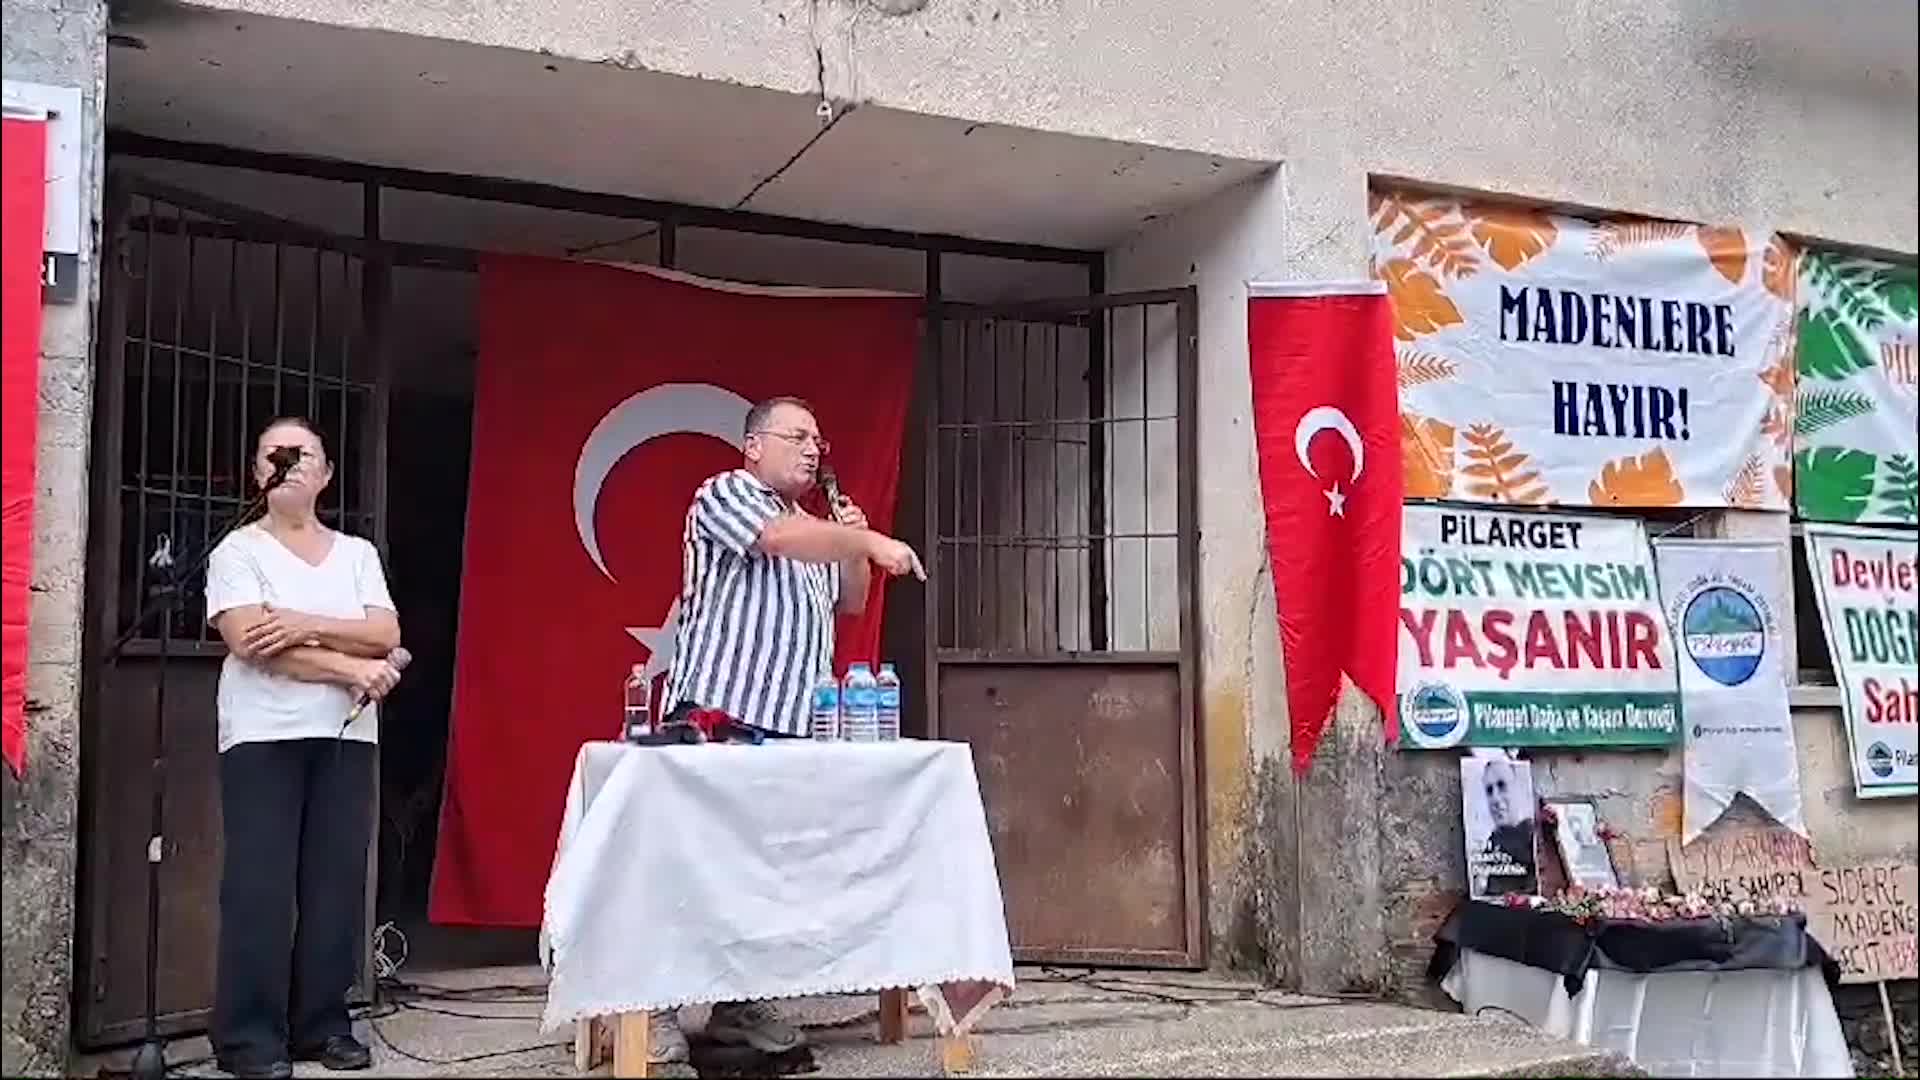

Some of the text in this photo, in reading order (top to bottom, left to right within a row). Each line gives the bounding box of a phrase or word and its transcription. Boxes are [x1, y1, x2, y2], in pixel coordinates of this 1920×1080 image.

[1499, 284, 1736, 357] MADENLERE
[1552, 380, 1690, 440] HAYIR!
[1504, 561, 1651, 600] MEVSİM
[1401, 609, 1661, 680] YAŞANIR
